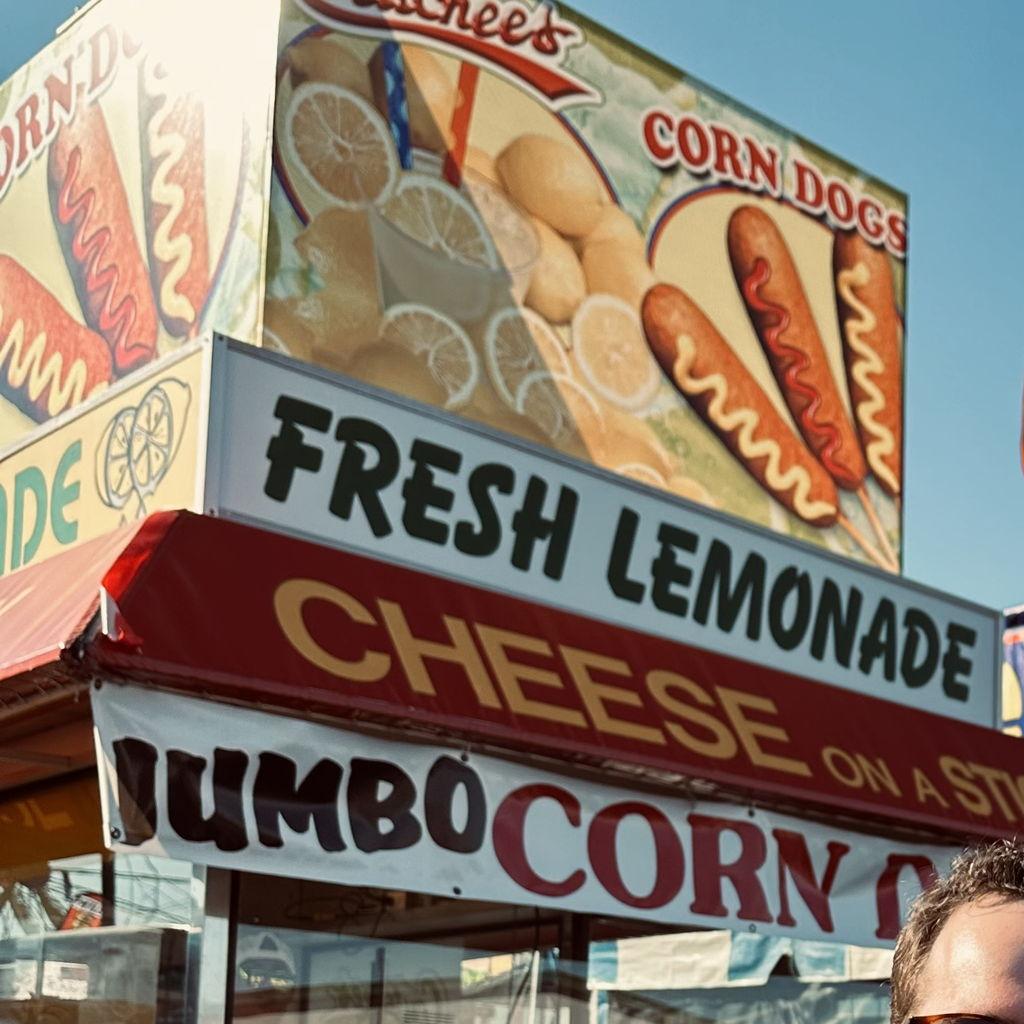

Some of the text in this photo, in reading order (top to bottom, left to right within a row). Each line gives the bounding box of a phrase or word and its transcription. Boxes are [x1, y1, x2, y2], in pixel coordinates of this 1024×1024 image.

[643, 110, 907, 252] CORN DOGS
[0, 438, 82, 577] DE
[264, 394, 977, 702] FRESH LEMONADE
[273, 578, 811, 777] CHEESE
[822, 745, 901, 798] ON
[913, 767, 949, 807] A
[112, 736, 487, 854] JUMBO
[492, 782, 850, 934] CORN
